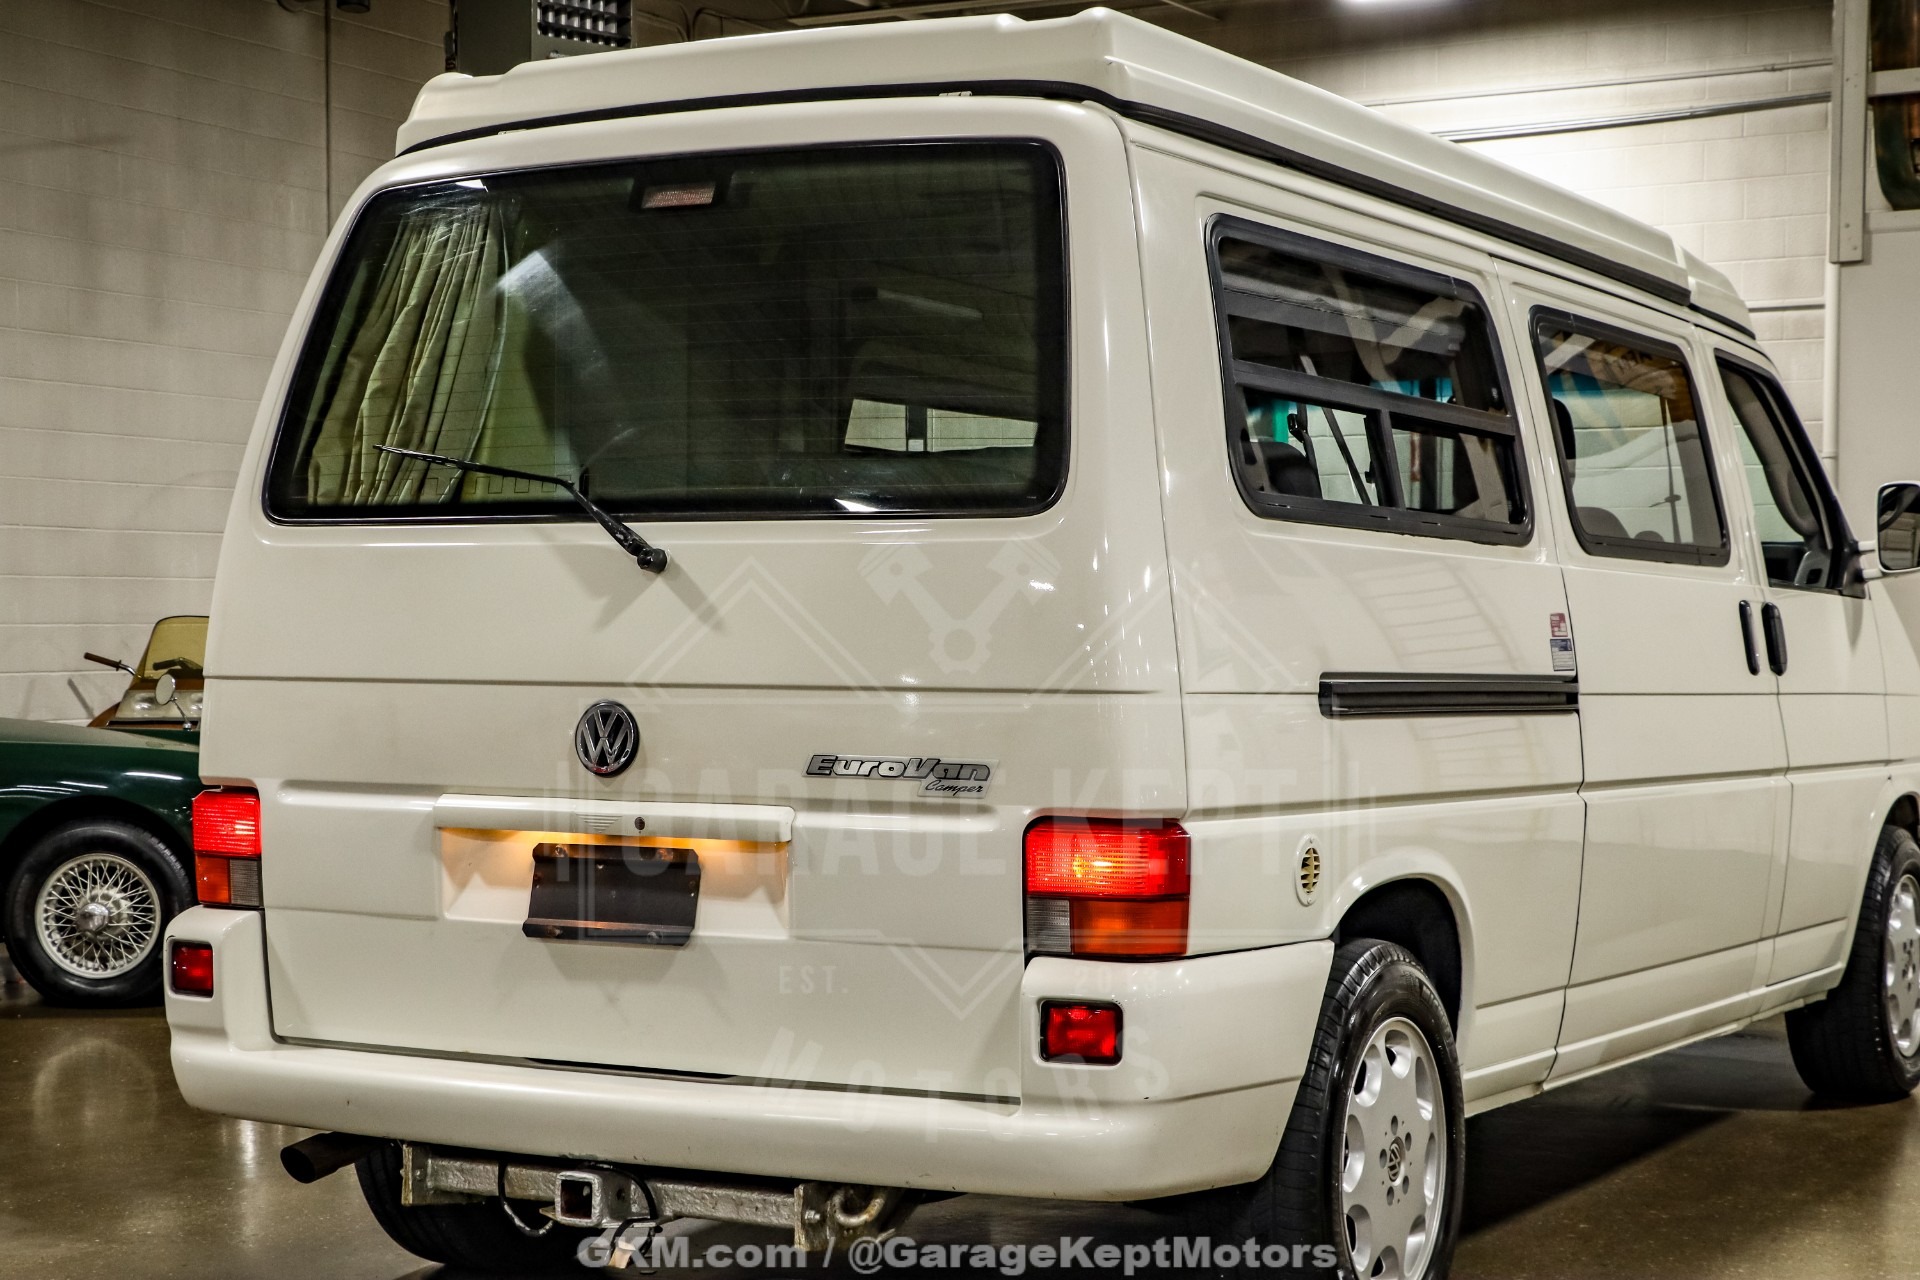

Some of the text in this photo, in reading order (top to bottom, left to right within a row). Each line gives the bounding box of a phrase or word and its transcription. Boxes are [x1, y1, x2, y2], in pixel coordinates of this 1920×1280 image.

[577, 702, 636, 774] VW
[806, 754, 991, 782] EuroVan
[925, 779, 984, 797] Camper
